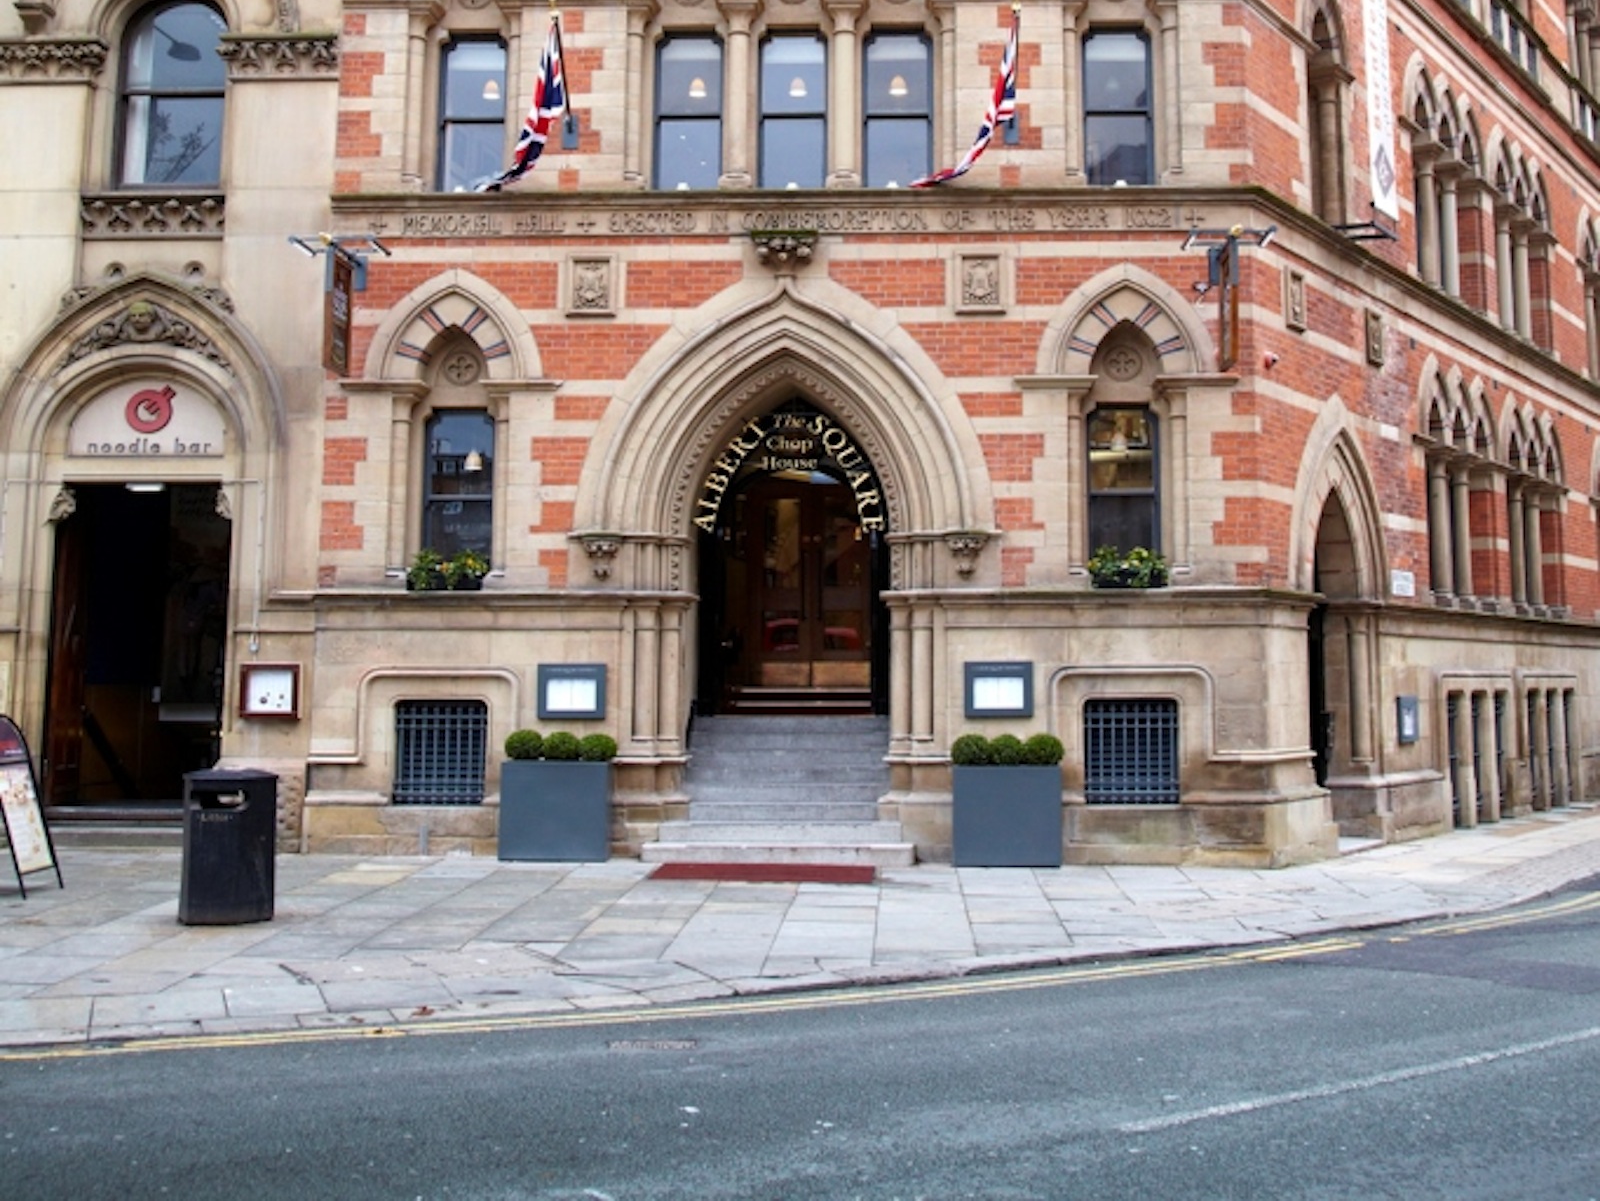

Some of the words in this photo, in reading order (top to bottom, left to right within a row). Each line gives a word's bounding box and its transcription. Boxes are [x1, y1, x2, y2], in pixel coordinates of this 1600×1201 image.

[512, 212, 565, 234] HALL
[941, 209, 976, 231] OF
[988, 209, 1036, 231] THE
[1047, 207, 1110, 229] YEAR
[87, 437, 161, 455] noodle
[174, 436, 212, 455] bar
[765, 434, 814, 455] Chop
[761, 455, 818, 470] House
[692, 416, 767, 534] ALBERT
[806, 413, 885, 534] SQUARE
